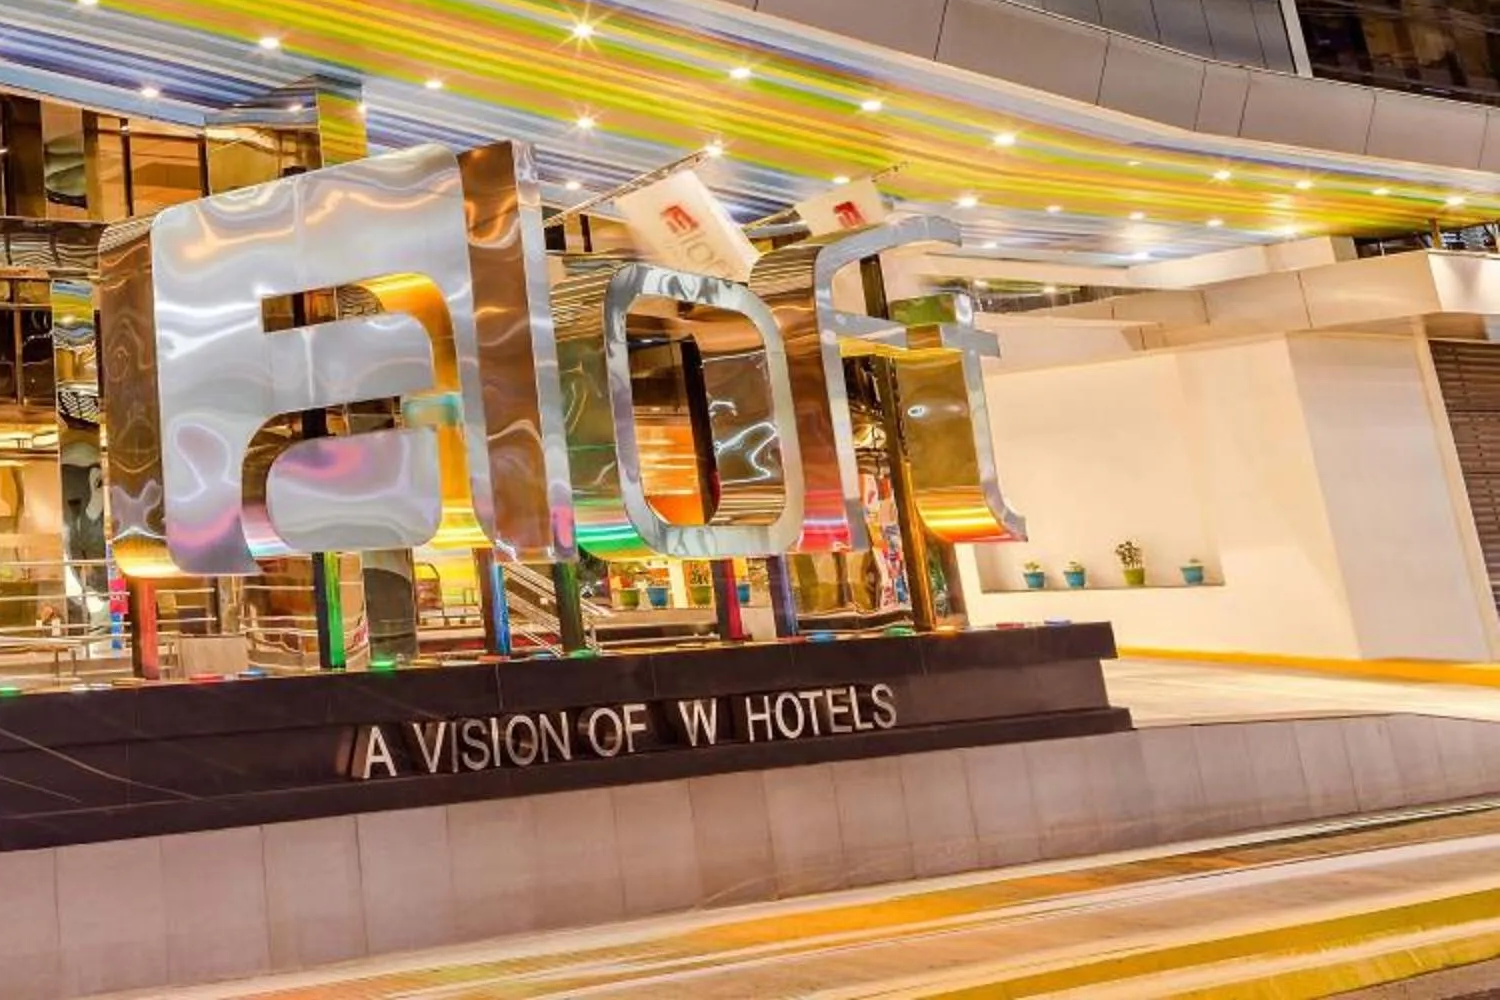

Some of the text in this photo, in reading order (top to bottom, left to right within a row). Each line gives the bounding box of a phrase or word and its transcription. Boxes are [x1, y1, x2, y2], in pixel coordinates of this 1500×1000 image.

[363, 683, 897, 778] A VISION OF W HOTELS
